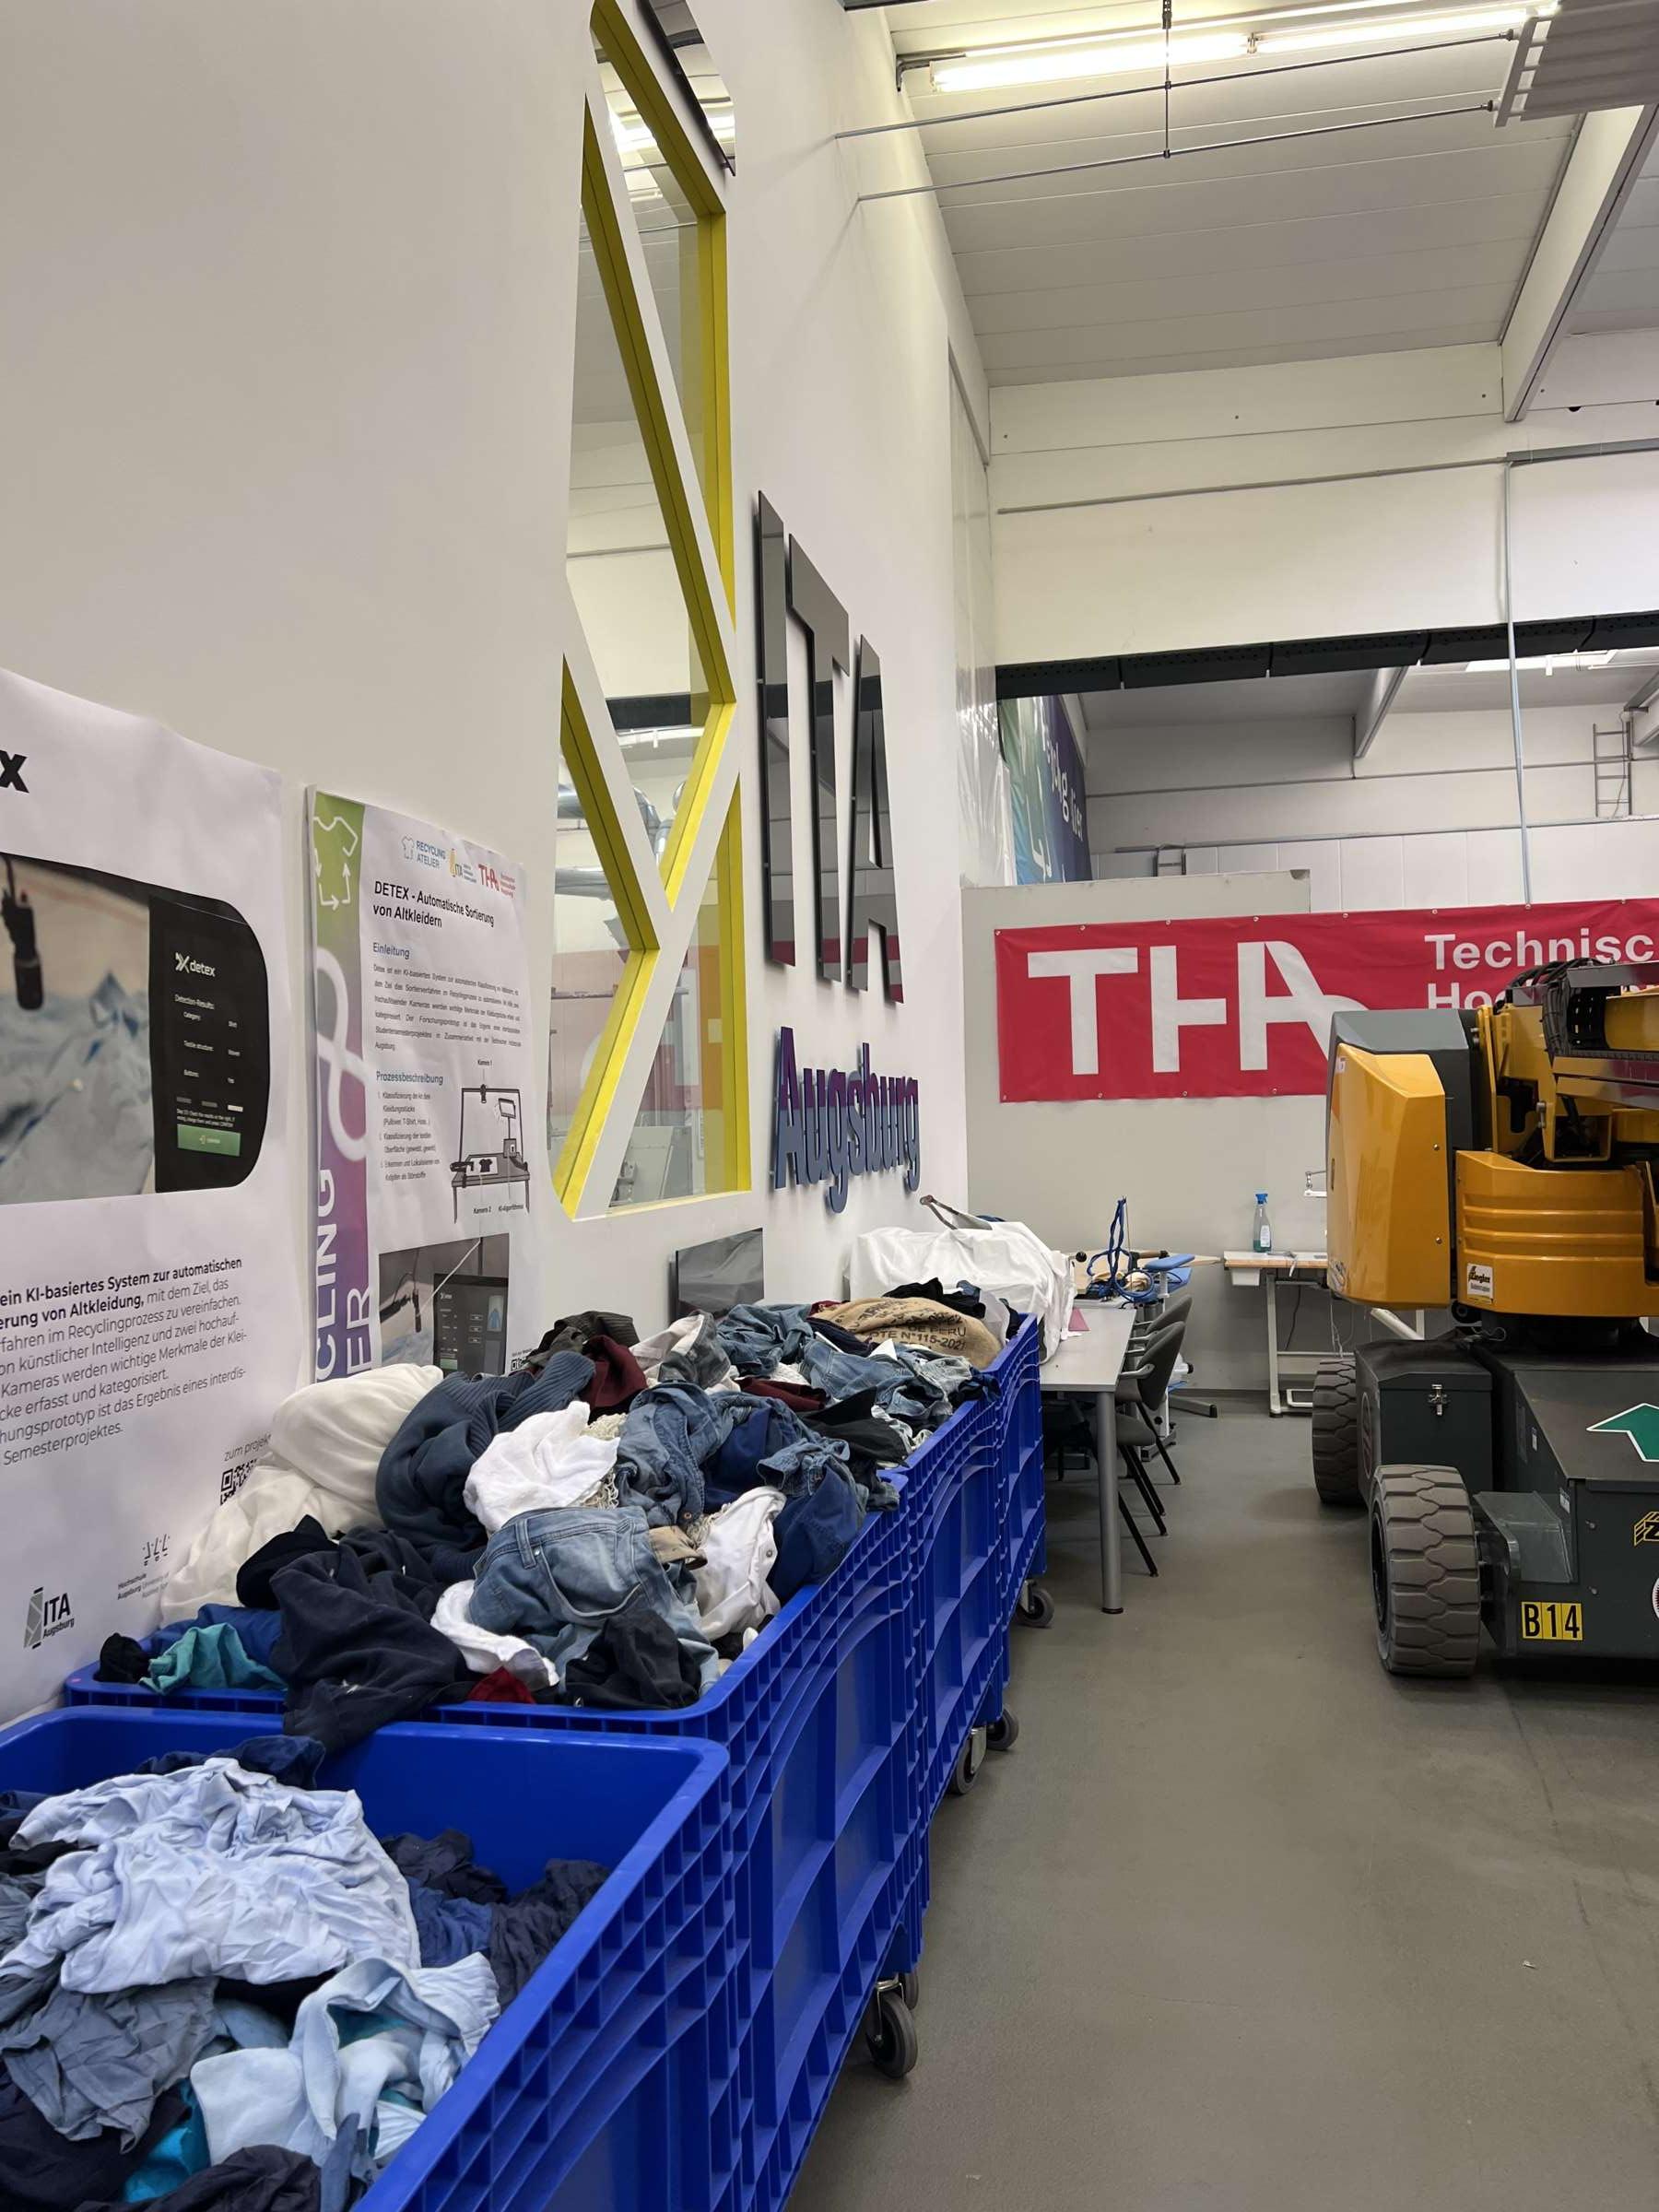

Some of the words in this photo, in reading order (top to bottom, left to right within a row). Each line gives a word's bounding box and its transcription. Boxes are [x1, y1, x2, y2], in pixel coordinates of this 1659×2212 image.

[759, 489, 904, 1003] ITA
[416, 840, 446, 860] RECYCLING
[416, 854, 441, 869] ATELIER
[373, 904, 392, 917] von
[394, 906, 442, 928] Altkleidern
[374, 880, 409, 900] DETEX
[417, 890, 465, 915] Automatische
[465, 904, 495, 928] Sortierung
[190, 959, 216, 977] detex
[372, 942, 410, 960] Einleitung
[1027, 940, 1362, 1076] THA
[376, 1070, 444, 1086] Prozessbeschreibung
[774, 1026, 921, 1213] Augsburg
[26, 1280, 105, 1302] KI-basiertes
[108, 1274, 150, 1292] System
[153, 1270, 171, 1283] zur
[172, 1258, 242, 1279] automatischen
[41, 1307, 66, 1322] von
[70, 1294, 145, 1318] Altkleidung,
[147, 1288, 165, 1304] mit
[168, 1285, 191, 1300] dem
[213, 1277, 229, 1291] das
[48, 1328, 65, 1343] im
[68, 1309, 164, 1340] Recyclingprozess
[166, 1308, 179, 1320] zu
[181, 1295, 241, 1316] vereinfachen.
[19, 1346, 89, 1372] künstlicher
[92, 1333, 150, 1357] Intelligenz
[152, 1325, 172, 1343] und
[174, 1320, 197, 1338] zwei
[199, 1312, 240, 1332] hochauf-
[1, 1373, 60, 1398] Kameras
[62, 1363, 108, 1384] werden
[110, 1351, 157, 1372] wichtige
[159, 1338, 208, 1361] Merkmale
[210, 1335, 226, 1348] der
[228, 1330, 247, 1346] Klei-
[25, 1394, 69, 1415] erfasst
[73, 1384, 96, 1403] und
[99, 1369, 169, 1396] kategorisiert.
[98, 1403, 112, 1418] ist
[114, 1397, 134, 1413] das
[136, 1382, 181, 1407] Ergebnis
[182, 1377, 208, 1394] eines
[209, 1366, 246, 1387] interdis-
[4, 1422, 124, 1465] Semesterprojektes.
[224, 1445, 243, 1462] zum
[43, 1593, 71, 1627] ITA
[117, 1584, 142, 1600] Augsburg
[42, 1618, 76, 1640] Augsburg
[1524, 1603, 1580, 1639] B14
